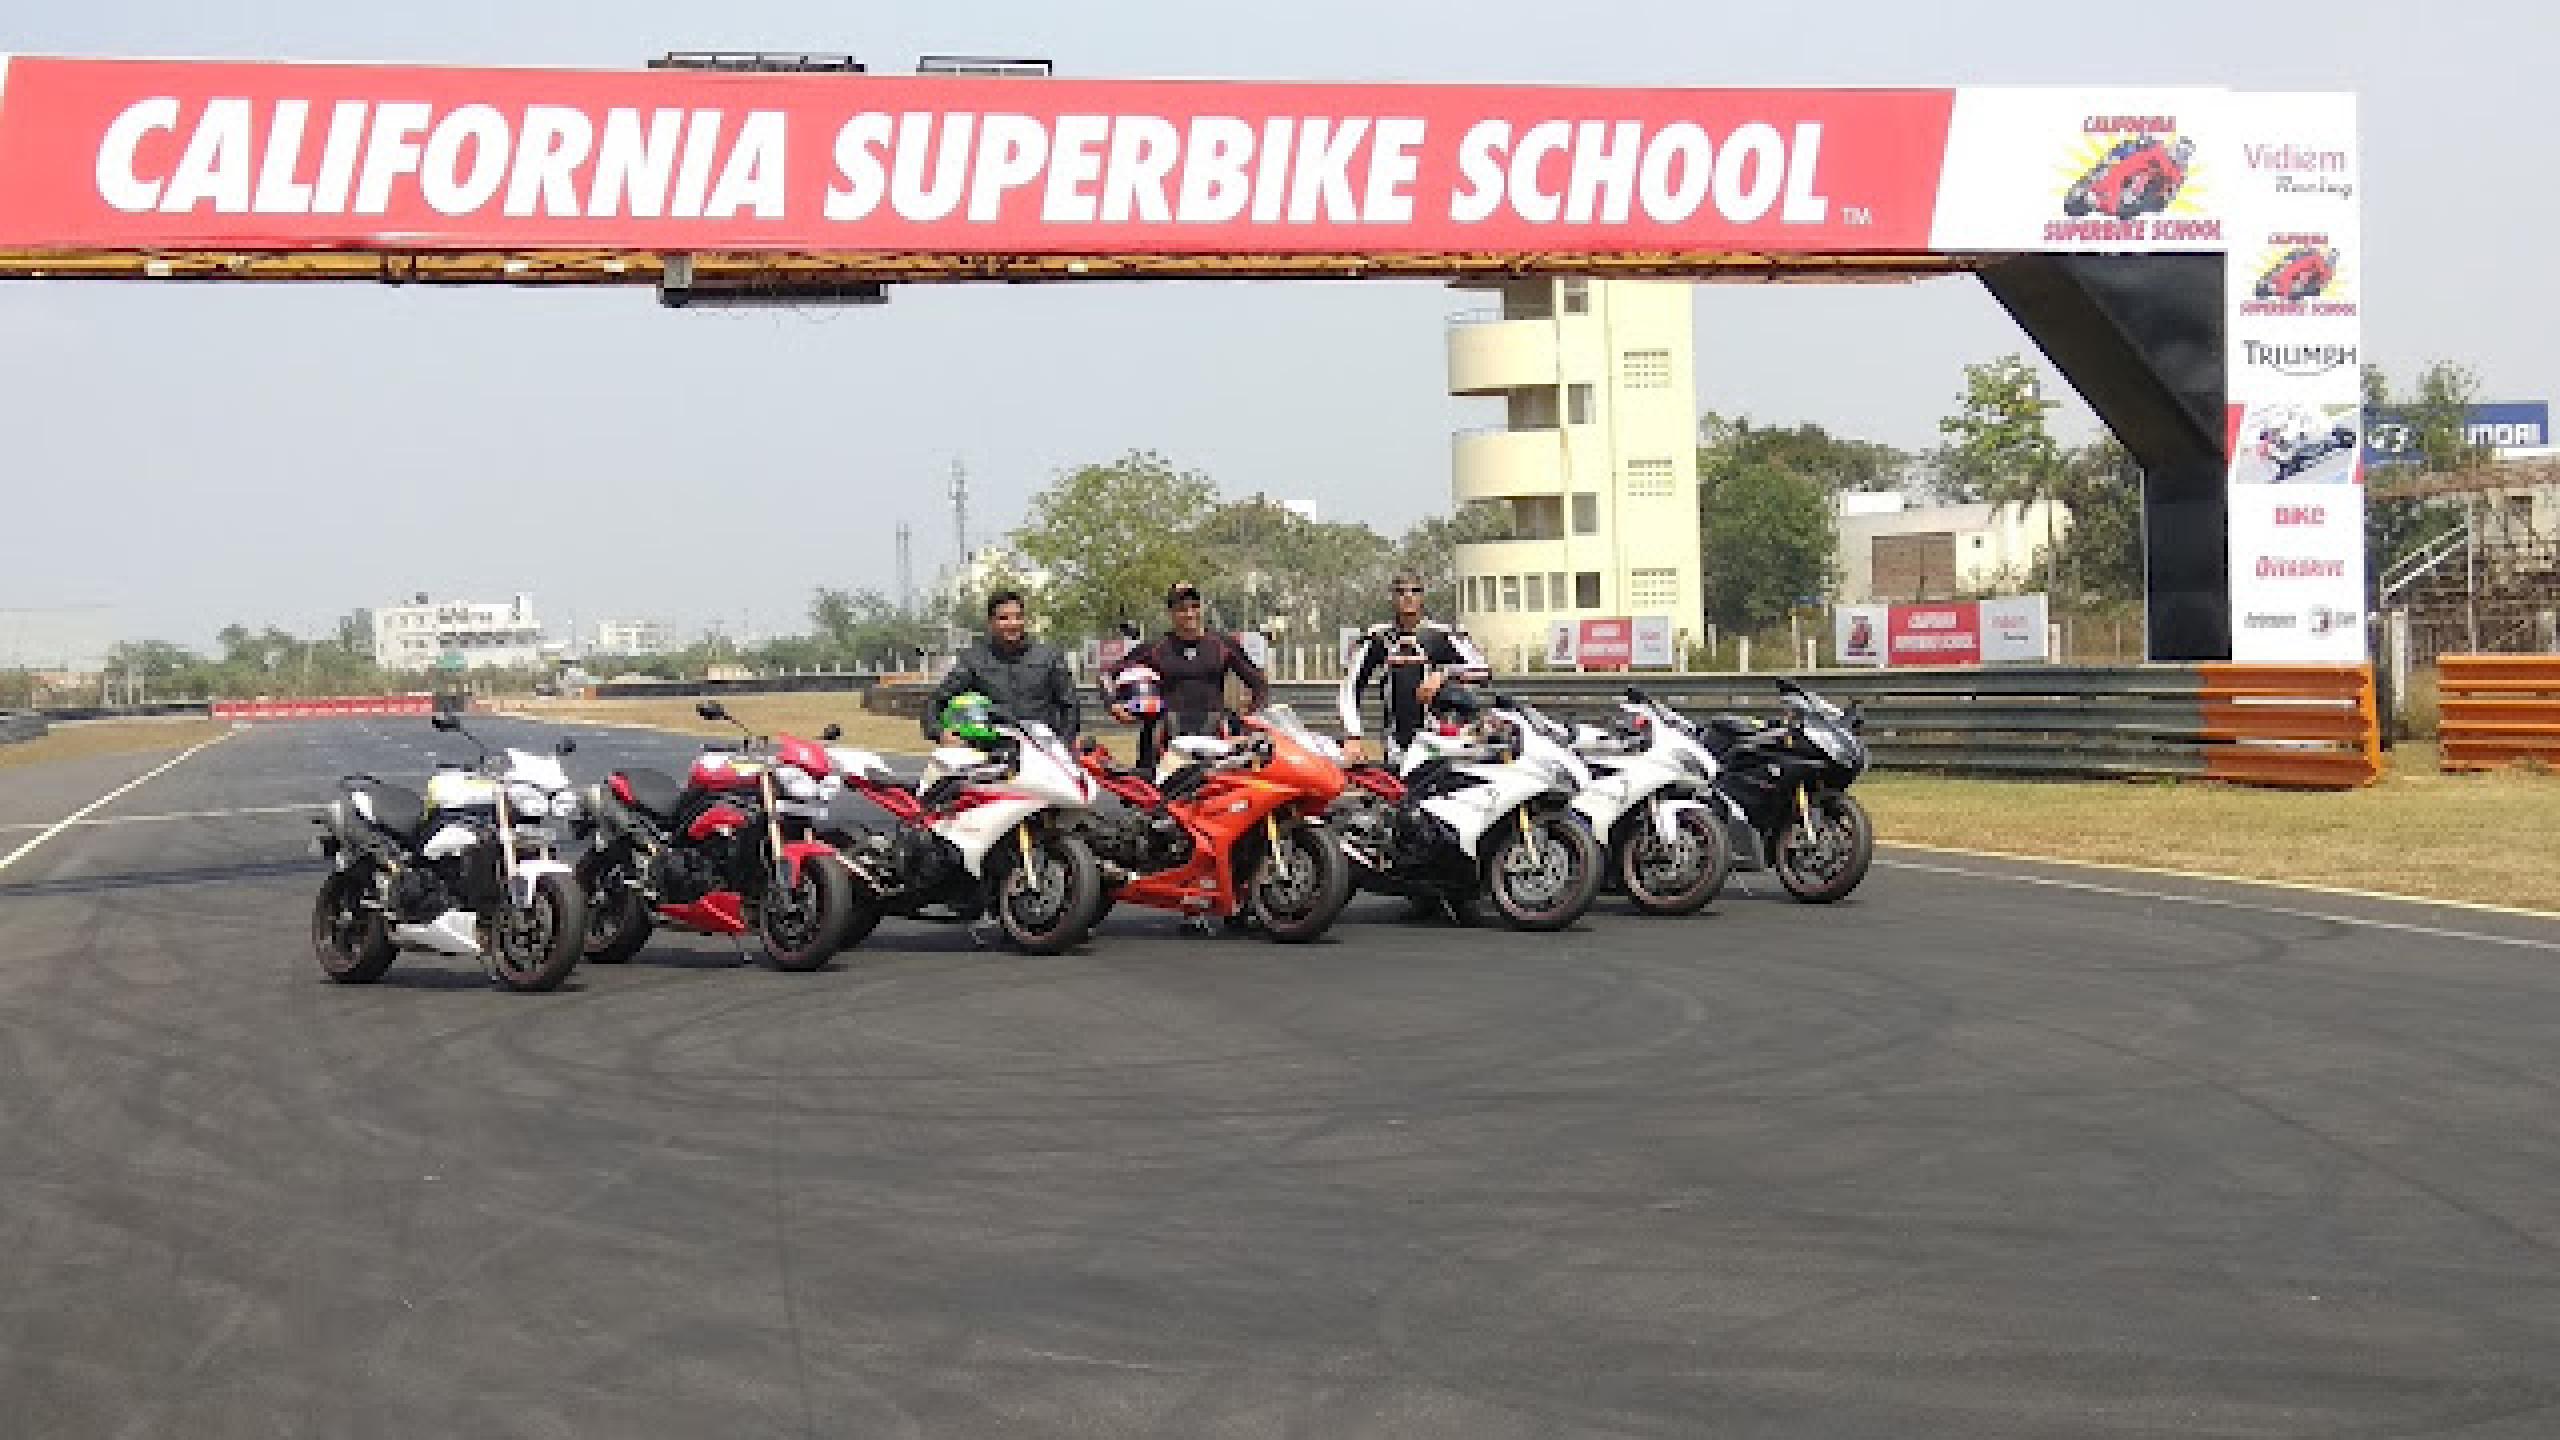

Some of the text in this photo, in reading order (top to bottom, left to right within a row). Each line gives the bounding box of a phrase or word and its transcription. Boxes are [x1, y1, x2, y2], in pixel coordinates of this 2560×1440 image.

[96, 96, 787, 220] CALIFORNIA
[824, 112, 1427, 224] SUPERBIKE
[1449, 119, 1829, 225] SCHOOL
[2151, 219, 2223, 241] SCHOOL
[2241, 339, 2357, 370] TRIUMPH
